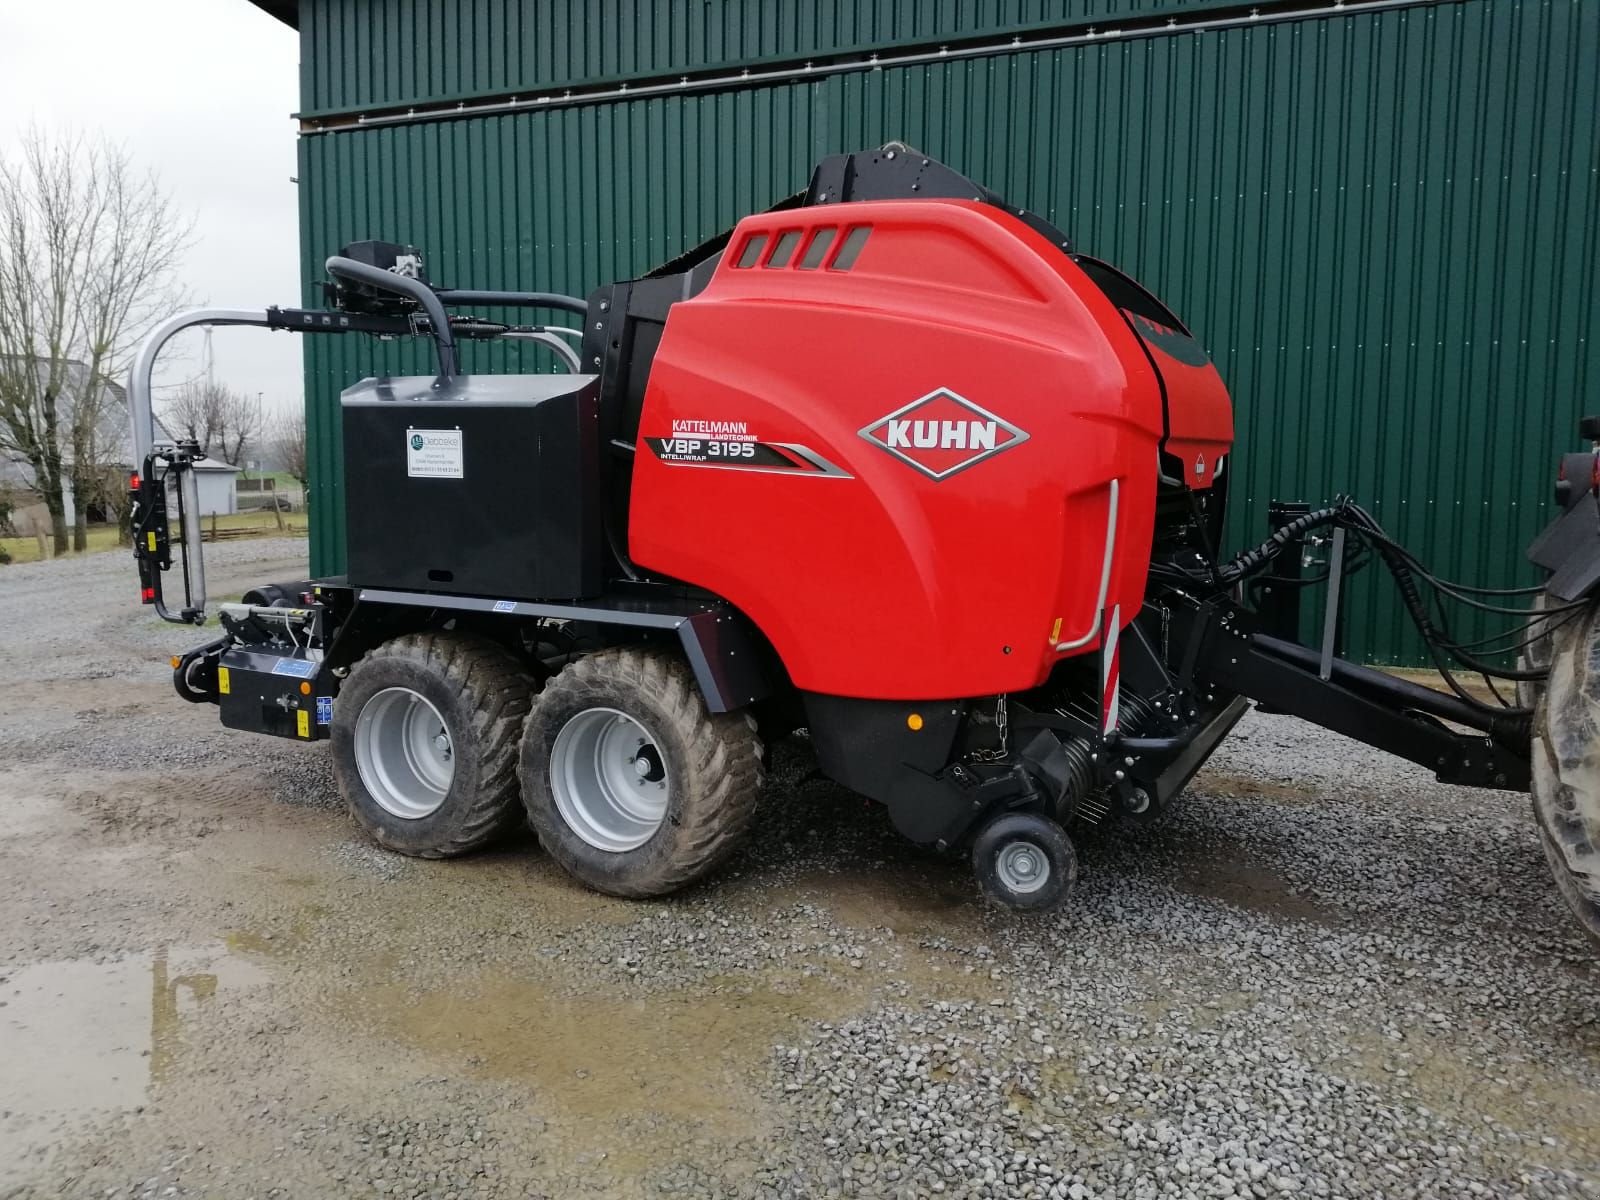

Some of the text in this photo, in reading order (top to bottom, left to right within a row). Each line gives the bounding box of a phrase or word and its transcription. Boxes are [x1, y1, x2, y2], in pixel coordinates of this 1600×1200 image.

[673, 420, 747, 434] KATTELMANN
[887, 419, 997, 450] KUHN
[661, 439, 755, 457] VBP 3195
